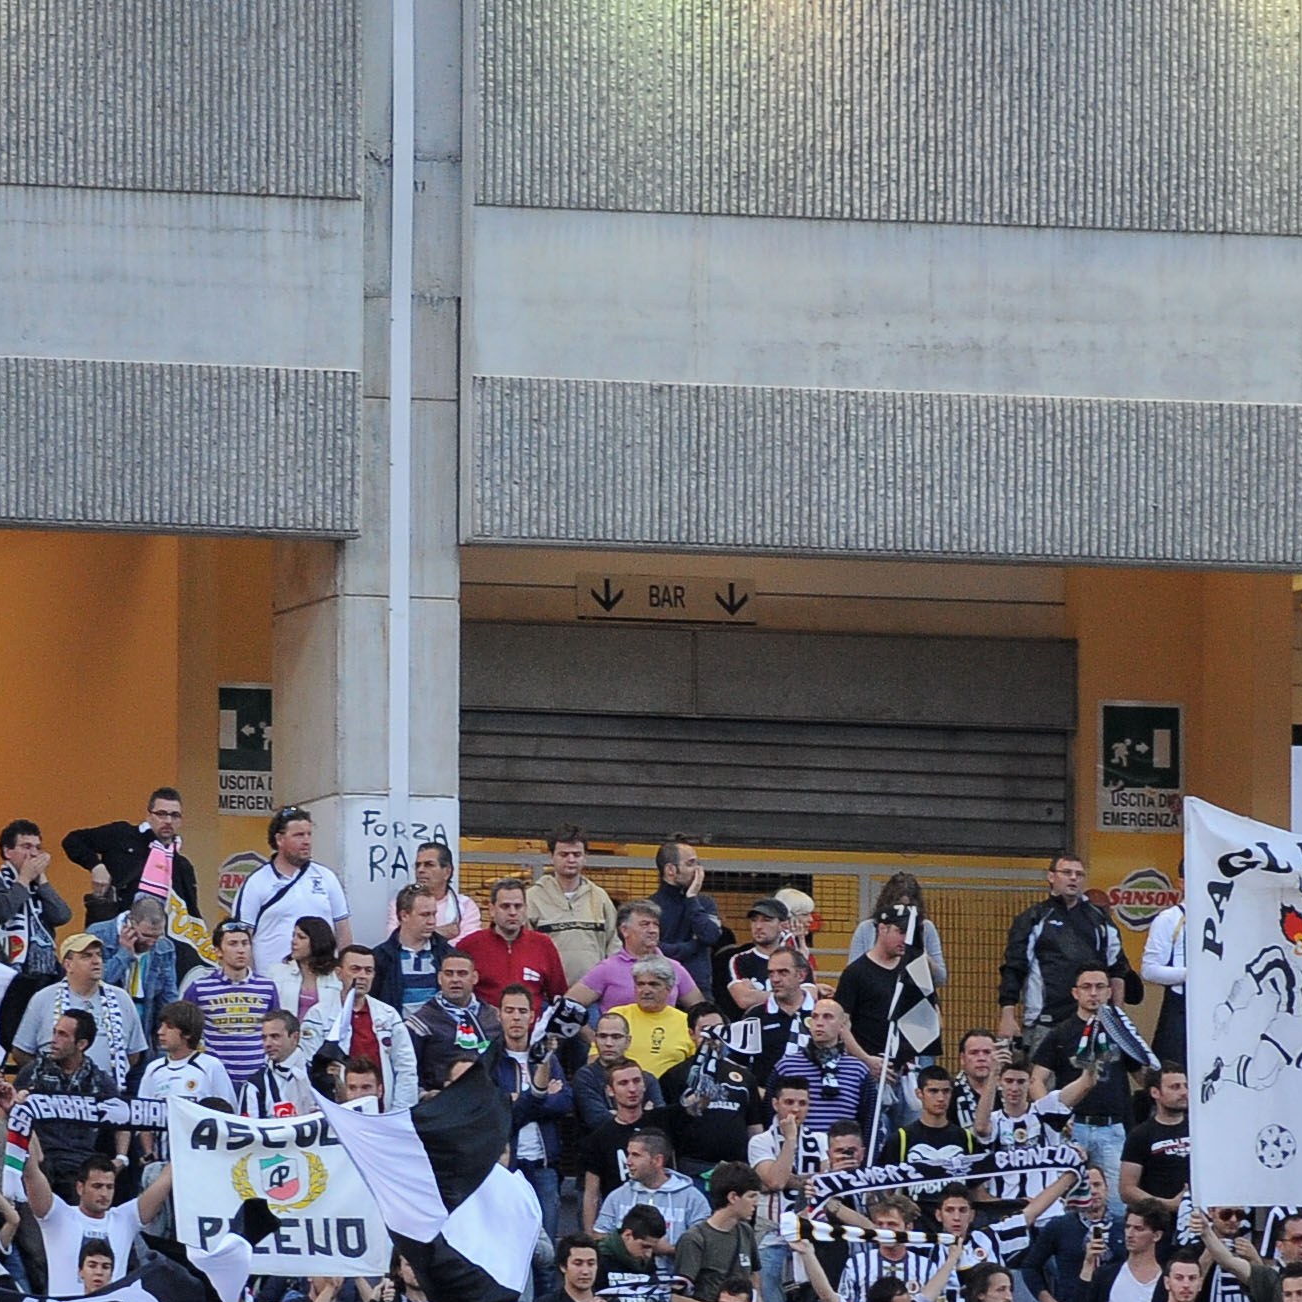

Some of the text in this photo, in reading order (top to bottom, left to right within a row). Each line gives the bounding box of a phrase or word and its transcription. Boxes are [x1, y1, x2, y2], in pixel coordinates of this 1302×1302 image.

[648, 584, 686, 609] BAR
[219, 775, 266, 791] USCITA
[1103, 811, 1180, 828] EMERGENZA
[1108, 887, 1180, 908] SANSON
[198, 1216, 368, 1260] PENO
